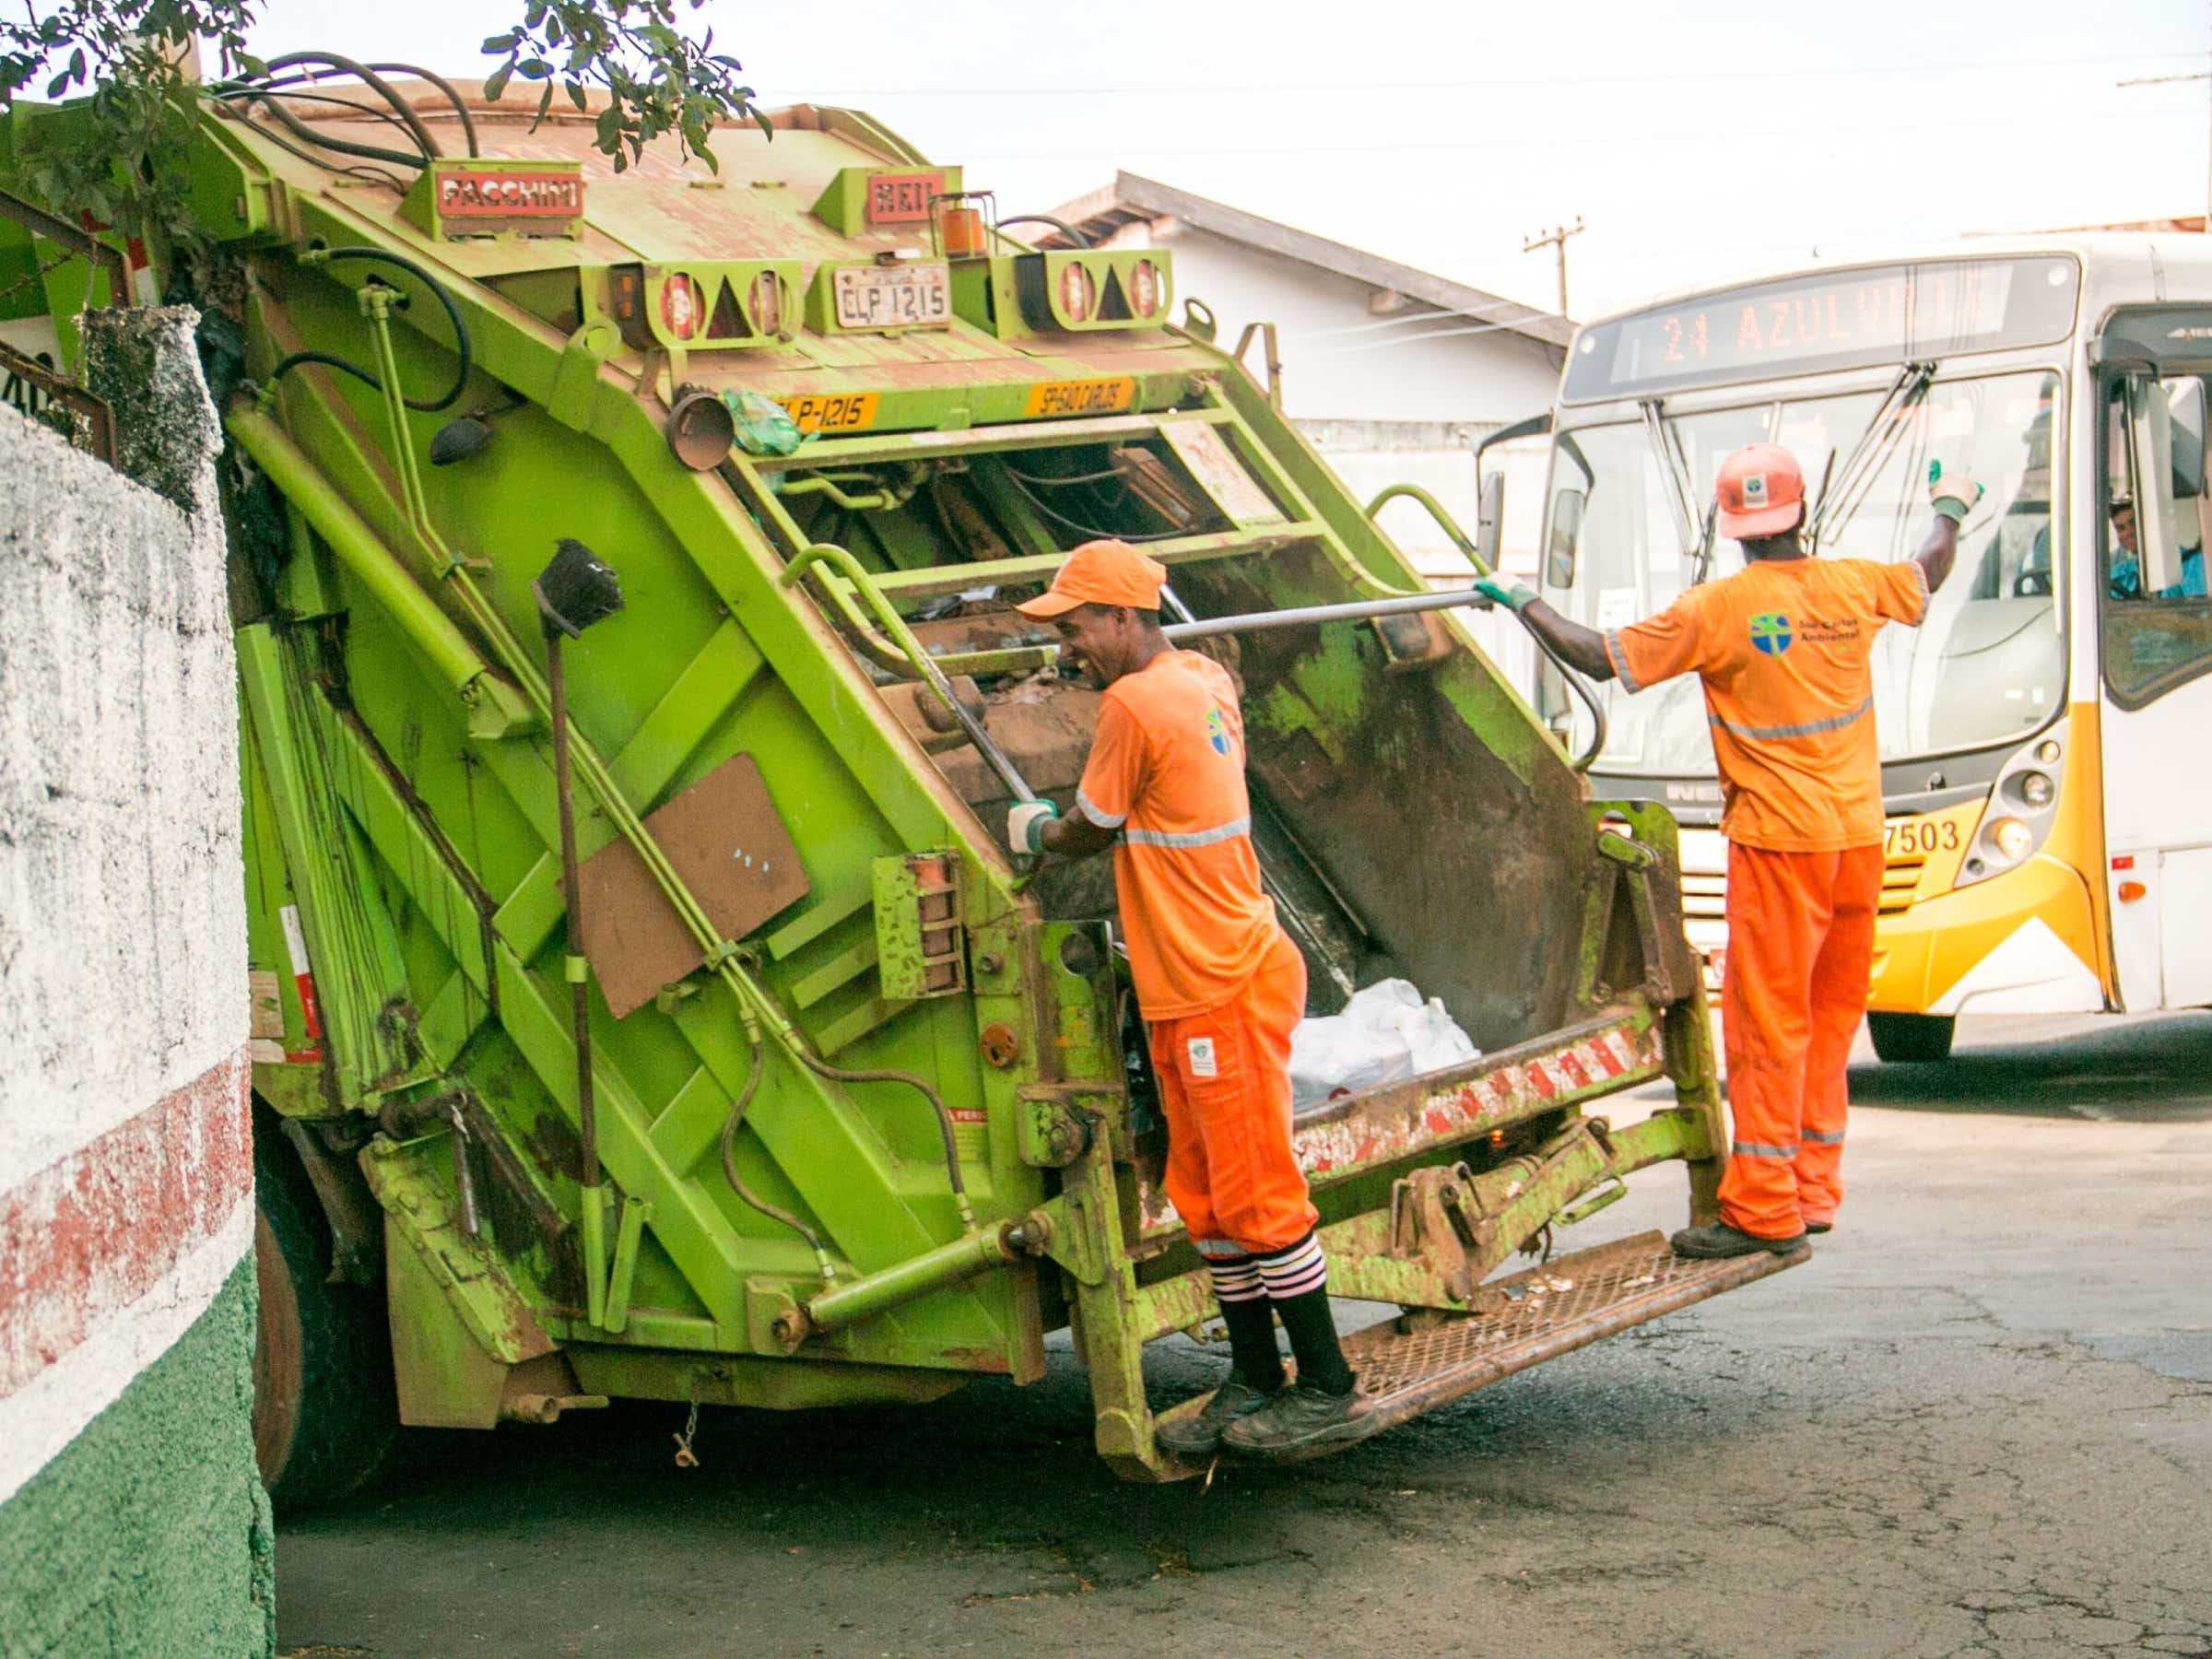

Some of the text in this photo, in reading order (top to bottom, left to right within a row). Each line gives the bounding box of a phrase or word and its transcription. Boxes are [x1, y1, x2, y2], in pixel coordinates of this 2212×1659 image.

[892, 286, 945, 317] 1215
[1663, 313, 1710, 362] 24
[778, 397, 865, 427] P-1215
[1886, 821, 1959, 853] 7503
